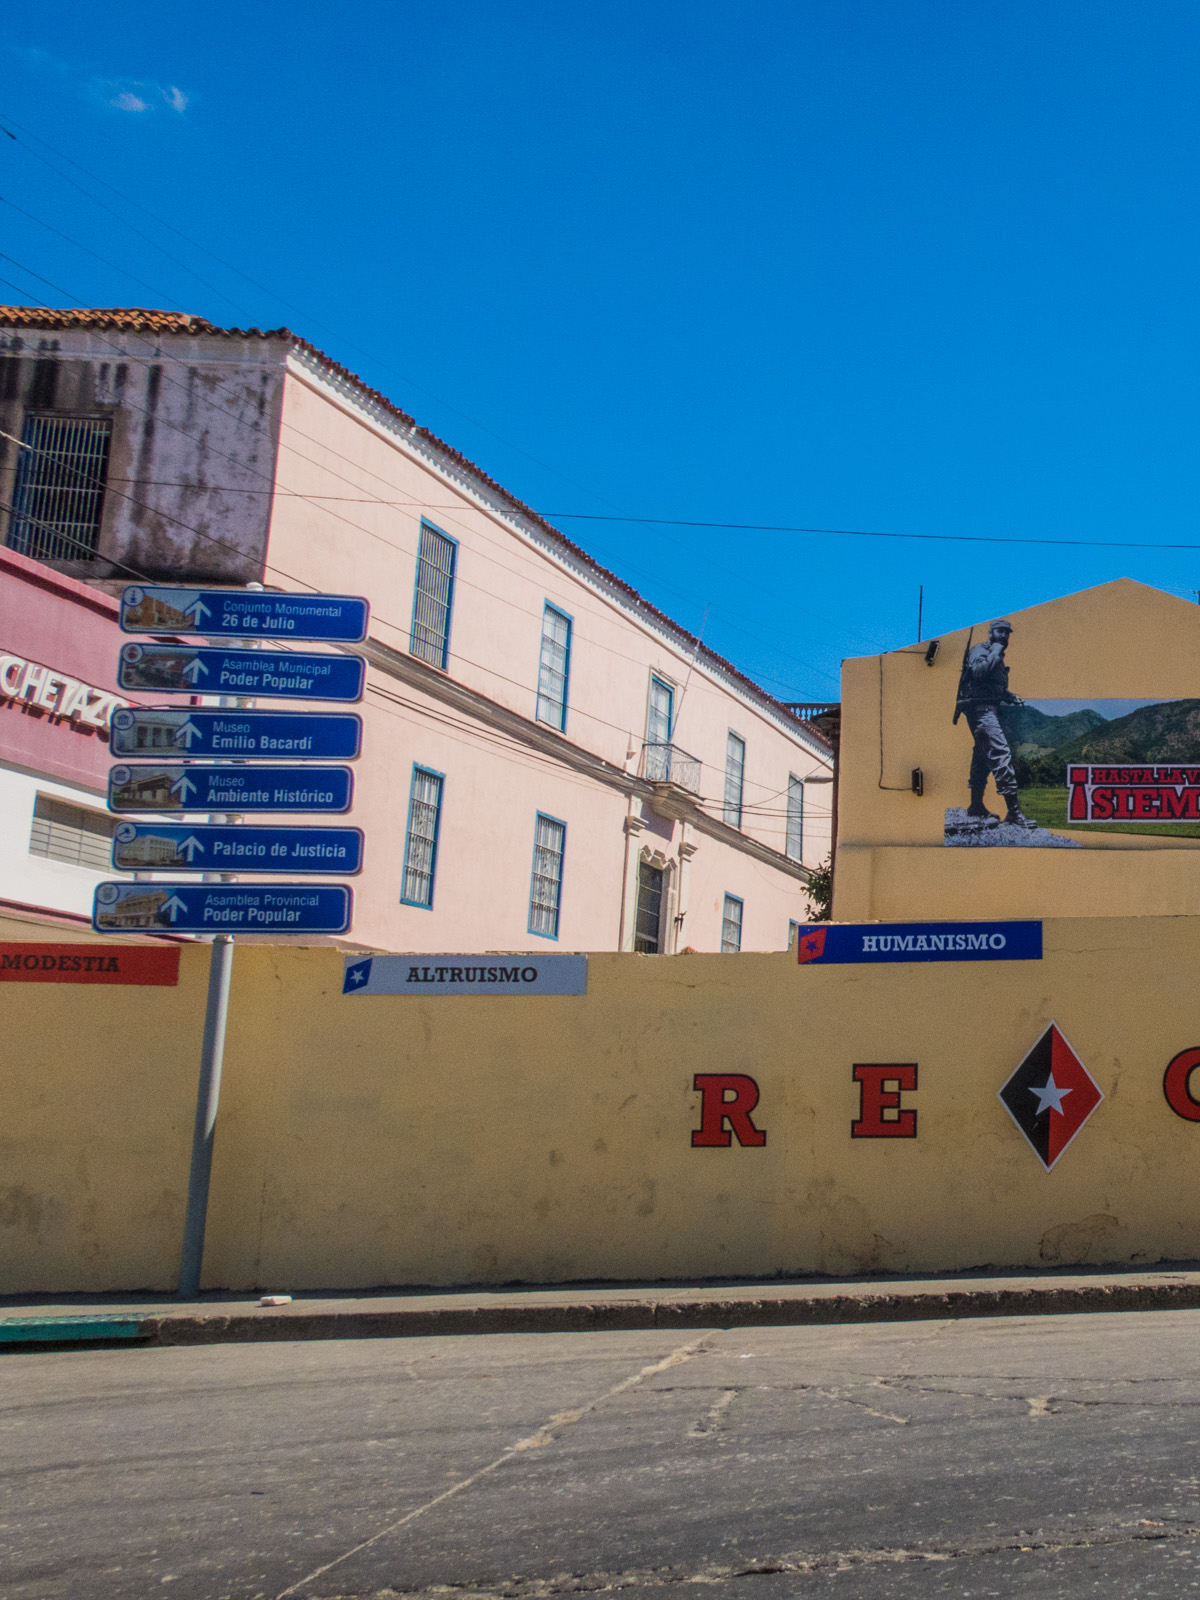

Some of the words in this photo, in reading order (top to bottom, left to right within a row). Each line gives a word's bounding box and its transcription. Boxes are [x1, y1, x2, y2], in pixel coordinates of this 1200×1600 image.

[223, 600, 272, 614] Conjunto
[275, 603, 342, 617] Monumental
[222, 614, 238, 627] 26
[242, 615, 259, 628] de
[262, 616, 295, 630] Julio
[222, 659, 275, 672] Asamblea
[279, 661, 331, 677] Municipal
[220, 671, 259, 686] Poder
[262, 673, 314, 690] Popular
[213, 721, 251, 733] Museo
[212, 735, 255, 749] Emilio
[260, 735, 313, 750] Bacardí
[208, 775, 245, 787] Museo
[1091, 767, 1155, 785] HASTA
[1157, 767, 1184, 785] LA
[207, 789, 270, 802] Ambiente
[274, 788, 333, 803] Histórico
[213, 841, 266, 856] Palacio
[270, 843, 287, 857] de
[291, 843, 346, 858] Justicia
[205, 894, 260, 906] Asamblea
[264, 894, 319, 906] Provincial
[203, 907, 244, 921] Poder
[248, 908, 301, 924] Popular
[862, 933, 1006, 952] HUMANISMO
[1, 954, 120, 973] MODESTIA
[406, 967, 539, 983] ALTRUISMO
